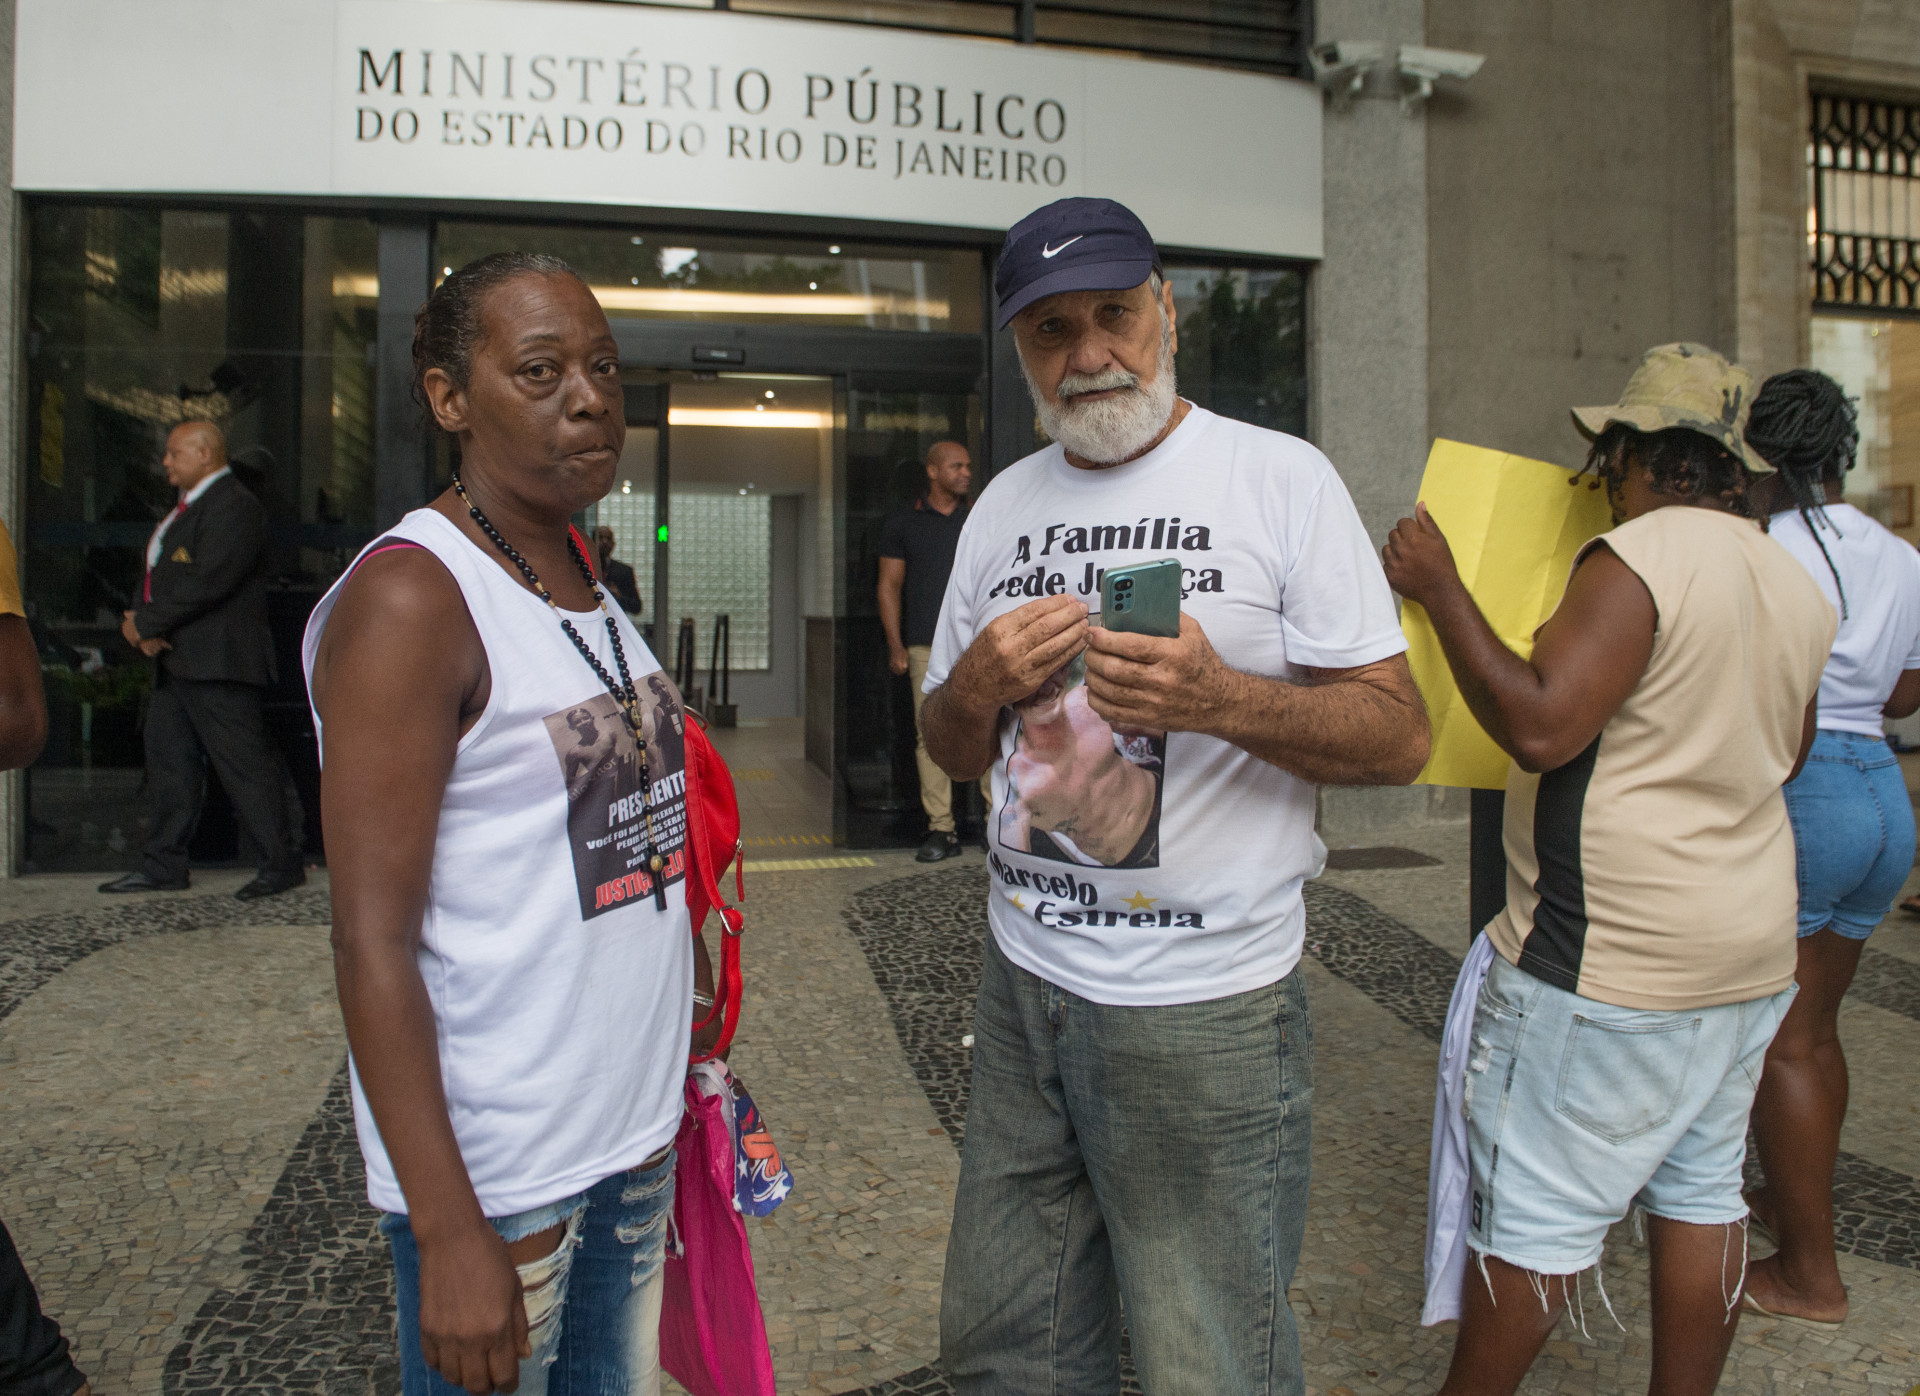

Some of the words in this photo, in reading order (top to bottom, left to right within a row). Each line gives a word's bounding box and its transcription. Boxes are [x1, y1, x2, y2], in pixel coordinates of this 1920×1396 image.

[355, 46, 771, 115] MINISTÉRIO
[803, 66, 1067, 144] PÚBLICO
[355, 106, 420, 143] DO
[442, 109, 624, 152] ESTADO
[645, 120, 705, 157] DO
[727, 125, 803, 163] RIO
[822, 132, 877, 169] DE
[894, 138, 1067, 187] JANEIRO
[1011, 535, 1031, 568] A
[1040, 517, 1212, 556] Família
[639, 805, 674, 830] COPLEXO
[640, 822, 663, 840] VOOS
[653, 834, 684, 855] TREGAR
[661, 849, 685, 881] ELO
[990, 852, 1098, 906] Marcelo
[1034, 900, 1205, 929] Estrela
